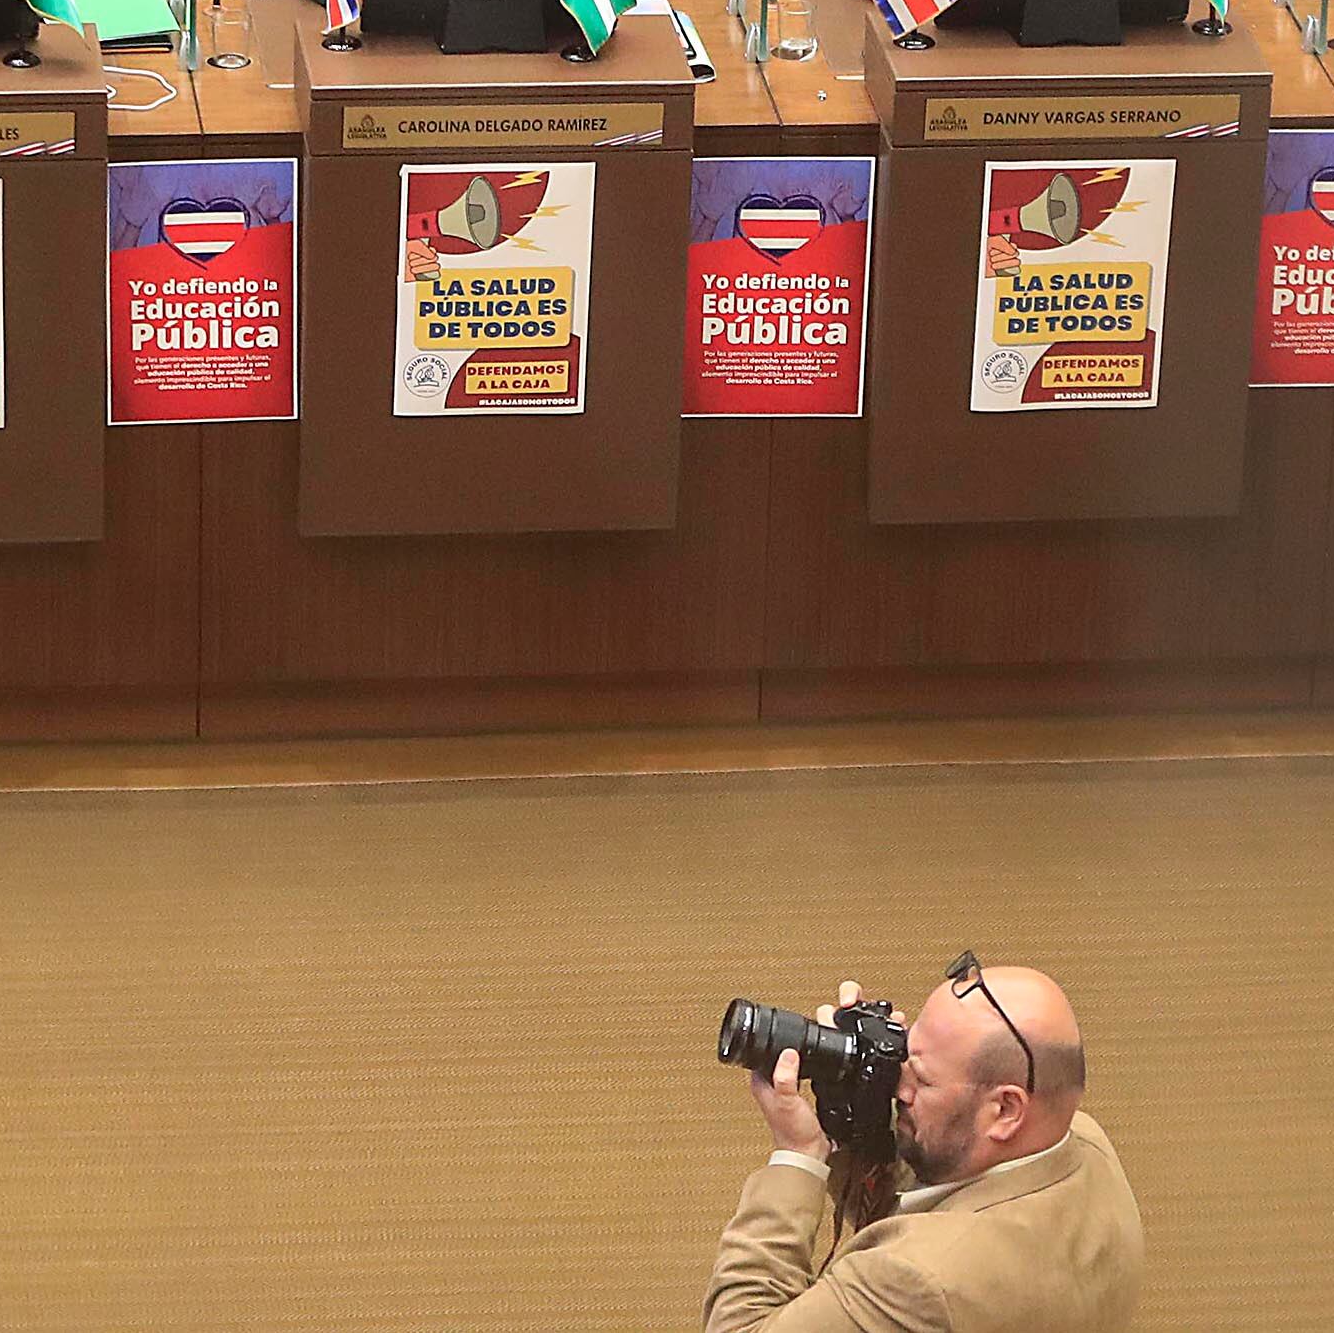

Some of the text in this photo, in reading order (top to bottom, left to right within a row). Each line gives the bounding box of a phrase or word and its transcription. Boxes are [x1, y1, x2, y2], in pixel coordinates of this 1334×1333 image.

[983, 109, 1181, 126] DANNY VARGAS SERRANO
[398, 119, 471, 135] CAROLINA
[476, 118, 543, 133] DELGADO
[1273, 246, 1299, 261] Yo
[129, 279, 277, 296] Yo defiendo la
[433, 279, 555, 296] LA SALUD
[702, 273, 849, 290] Yo defiendo la
[1014, 274, 1133, 291] LA SALUD
[130, 297, 279, 320] Educación
[419, 297, 566, 317] PÚBLICA ES
[703, 292, 849, 314] Educación
[1000, 292, 1143, 313] PÚBLICA ES
[429, 321, 556, 338] DE TODOS
[702, 315, 847, 345] Pública
[1009, 315, 1132, 333] DE TODOS
[131, 320, 278, 351] Pública
[467, 365, 565, 376] DEFENDAMOS
[1045, 359, 1140, 370] DEFENDAMOS
[478, 378, 549, 389] A LA CAJA
[774, 377, 795, 386] Costa
[1054, 372, 1124, 383] A LA CAJA
